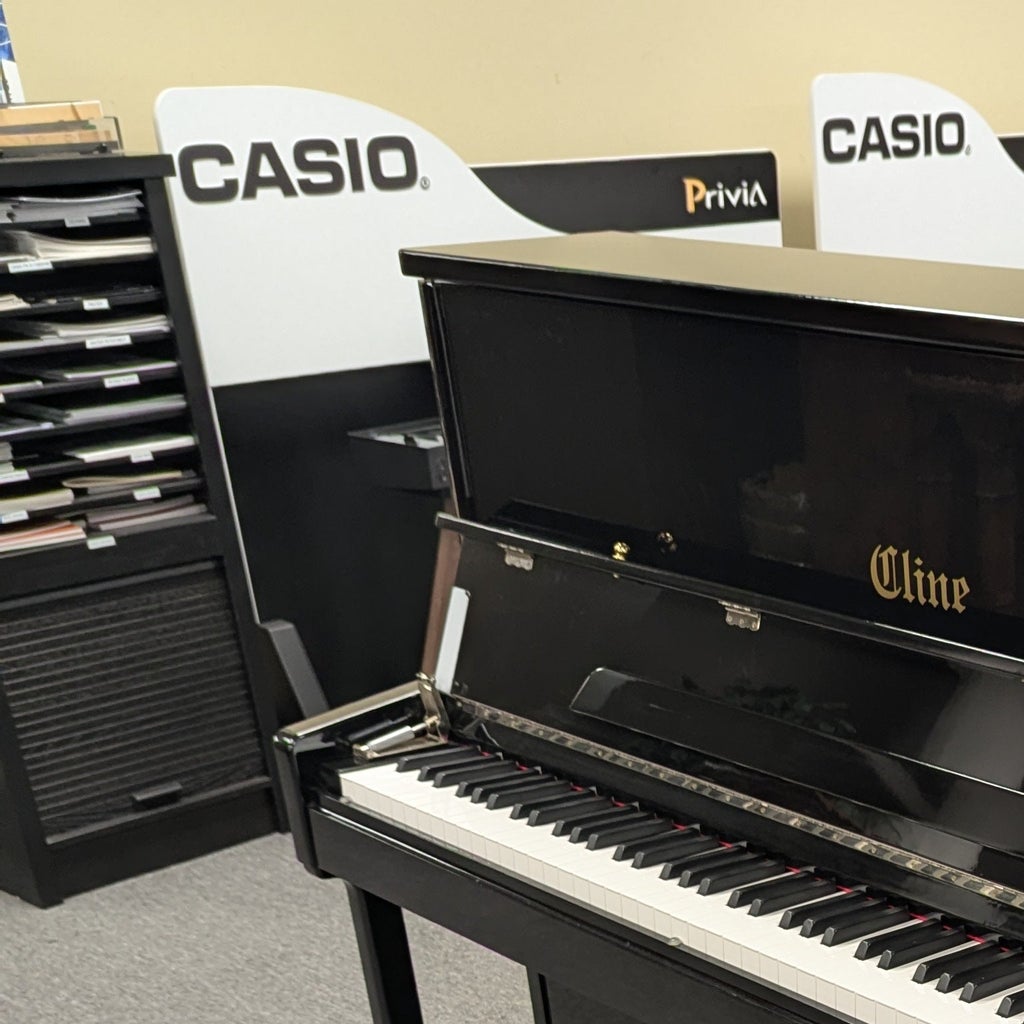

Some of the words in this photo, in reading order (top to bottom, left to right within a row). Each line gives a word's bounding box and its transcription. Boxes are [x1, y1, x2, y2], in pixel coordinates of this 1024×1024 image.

[178, 135, 418, 205] CASIO
[822, 112, 965, 164] CASIO
[870, 544, 970, 614] Cline
